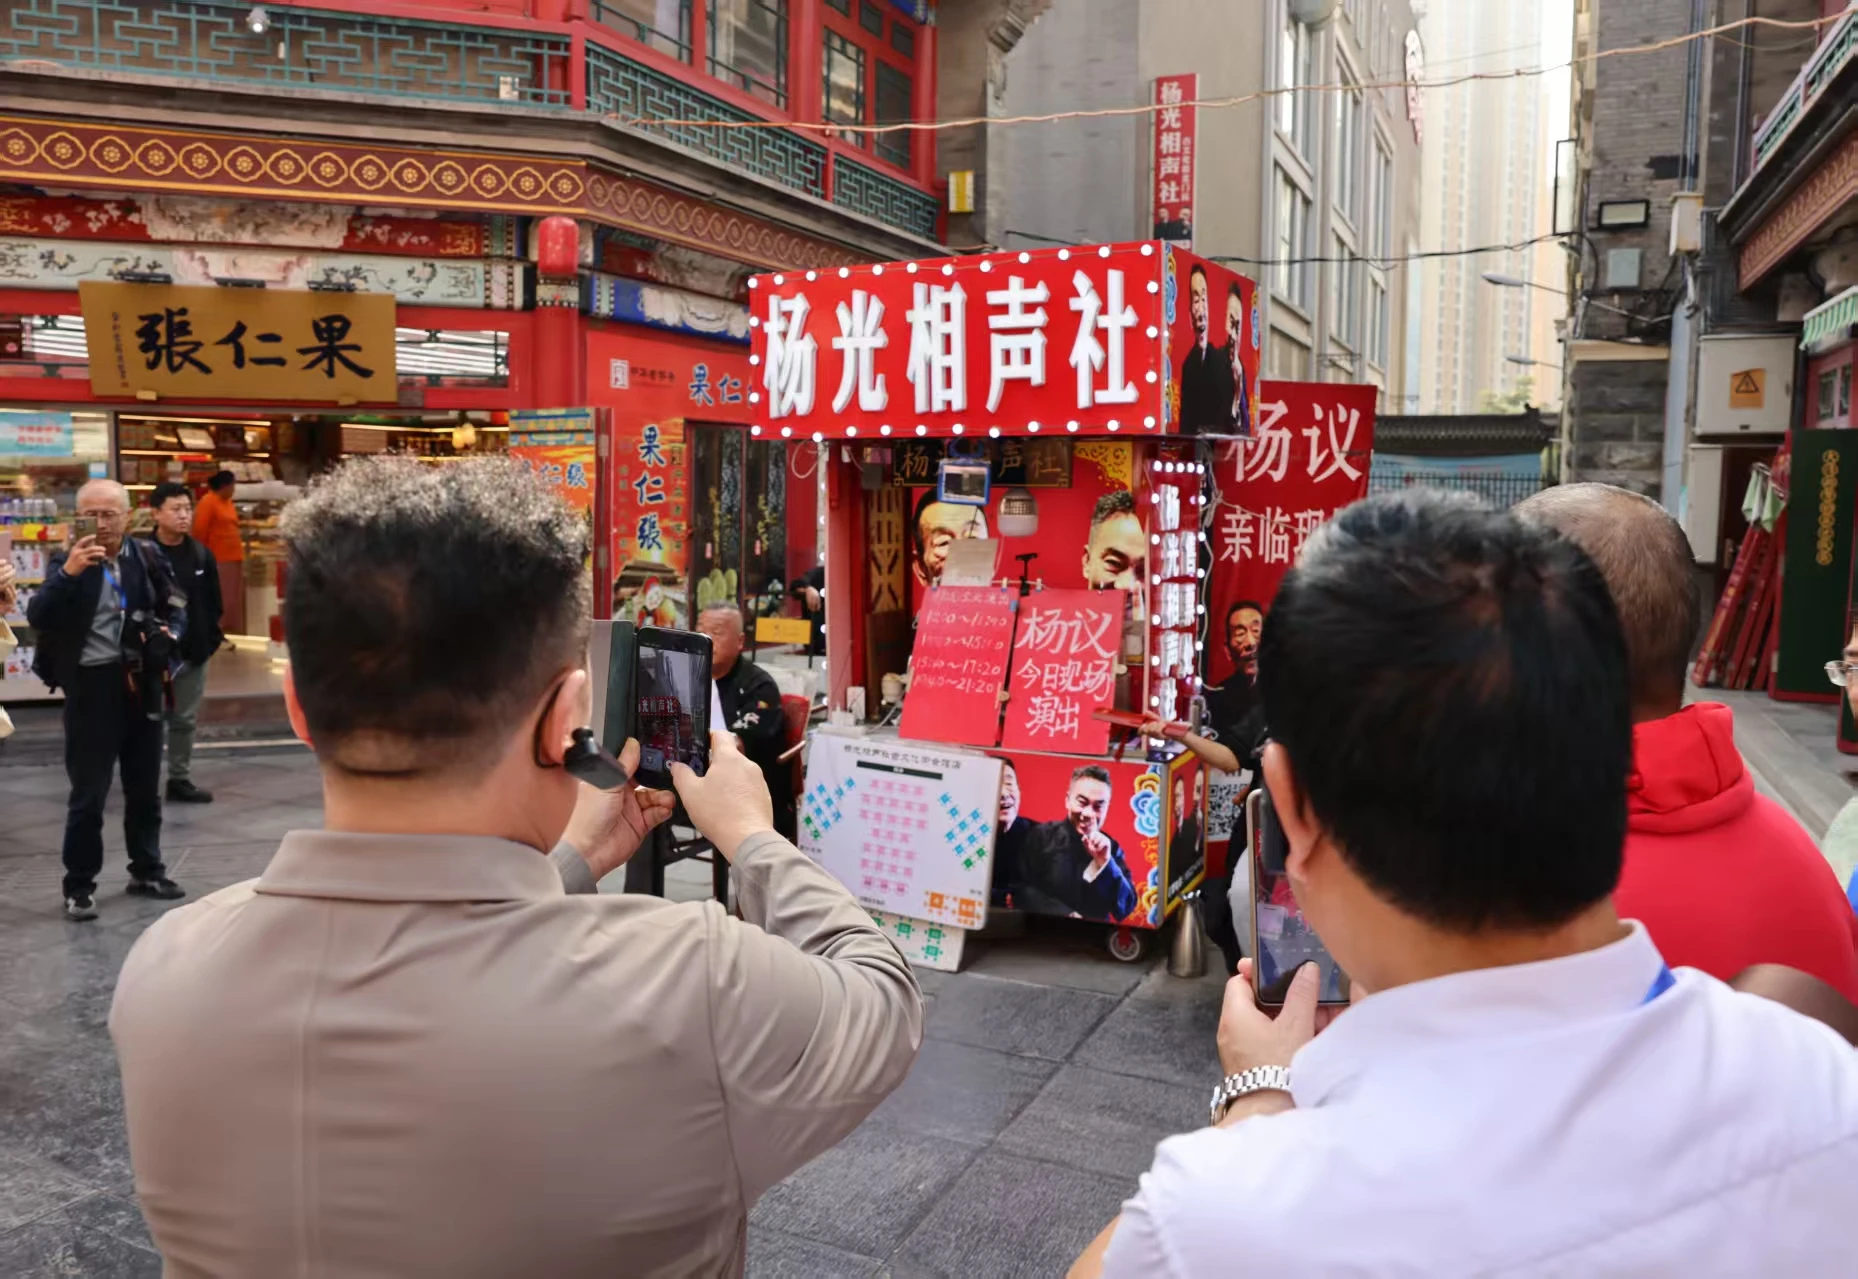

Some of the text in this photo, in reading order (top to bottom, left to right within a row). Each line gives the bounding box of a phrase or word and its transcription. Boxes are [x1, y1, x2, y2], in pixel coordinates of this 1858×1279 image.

[1159, 81, 1183, 204] 杨光相声社
[763, 268, 1139, 419] 杨光相声社
[688, 362, 751, 407] 果仁
[903, 443, 1063, 479] 杨声社
[1224, 399, 1363, 484] 杨议
[522, 460, 588, 488] 仁張
[1219, 504, 1340, 565] 亲临现
[1014, 607, 1118, 659] 杨议
[1017, 657, 1112, 702] 今日现场
[1025, 690, 1081, 740] 演出
